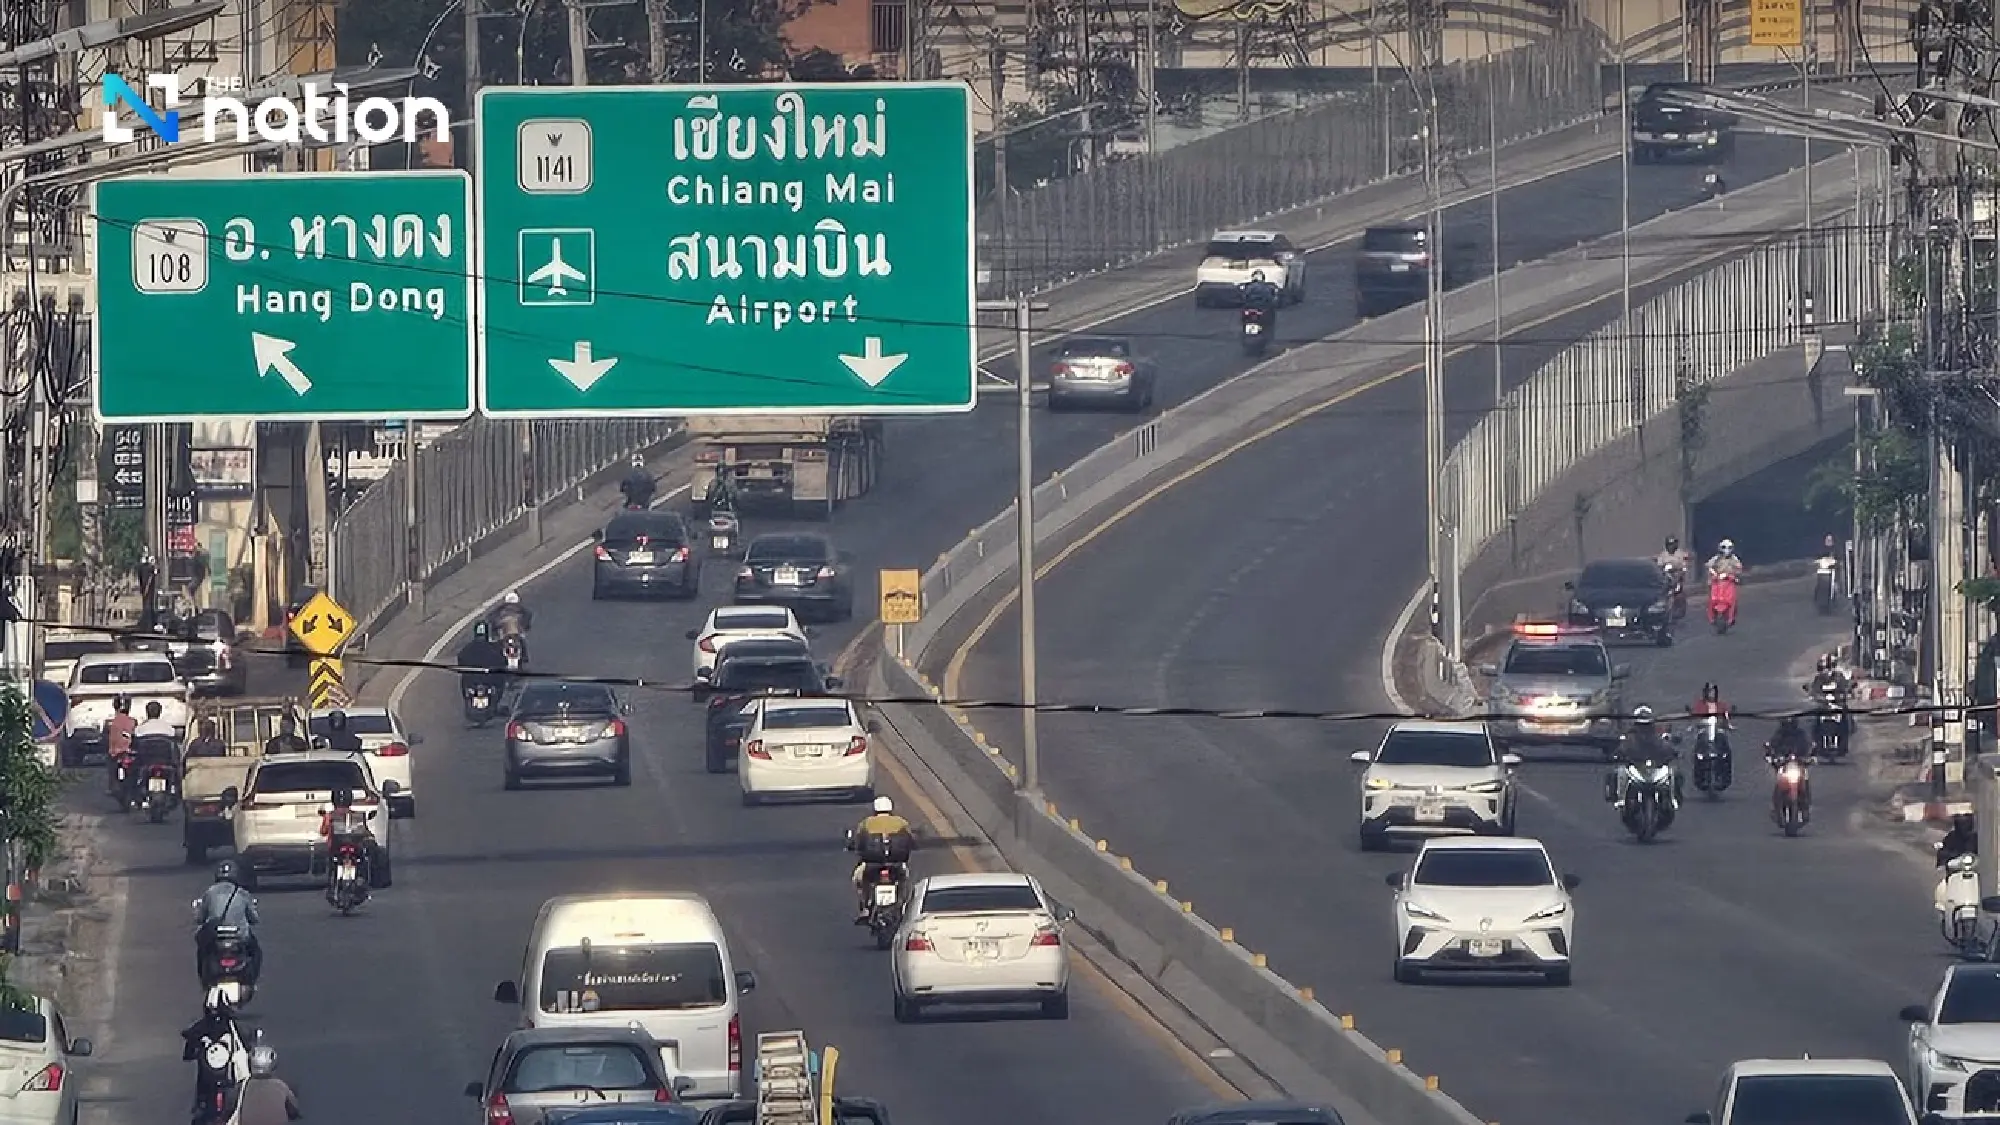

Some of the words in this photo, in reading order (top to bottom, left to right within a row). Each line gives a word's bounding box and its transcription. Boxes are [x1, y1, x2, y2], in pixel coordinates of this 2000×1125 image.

[673, 92, 887, 161] เชียงใหม่
[536, 154, 574, 183] 1141
[667, 174, 804, 213] Chiang
[825, 173, 896, 204] Mai
[224, 218, 271, 261] อ.
[290, 213, 453, 261] หางดง
[668, 218, 893, 281] สนามบิน
[150, 253, 190, 284] 108
[237, 284, 332, 323] Hang
[350, 283, 445, 321] Dong
[706, 294, 859, 331] Airport
